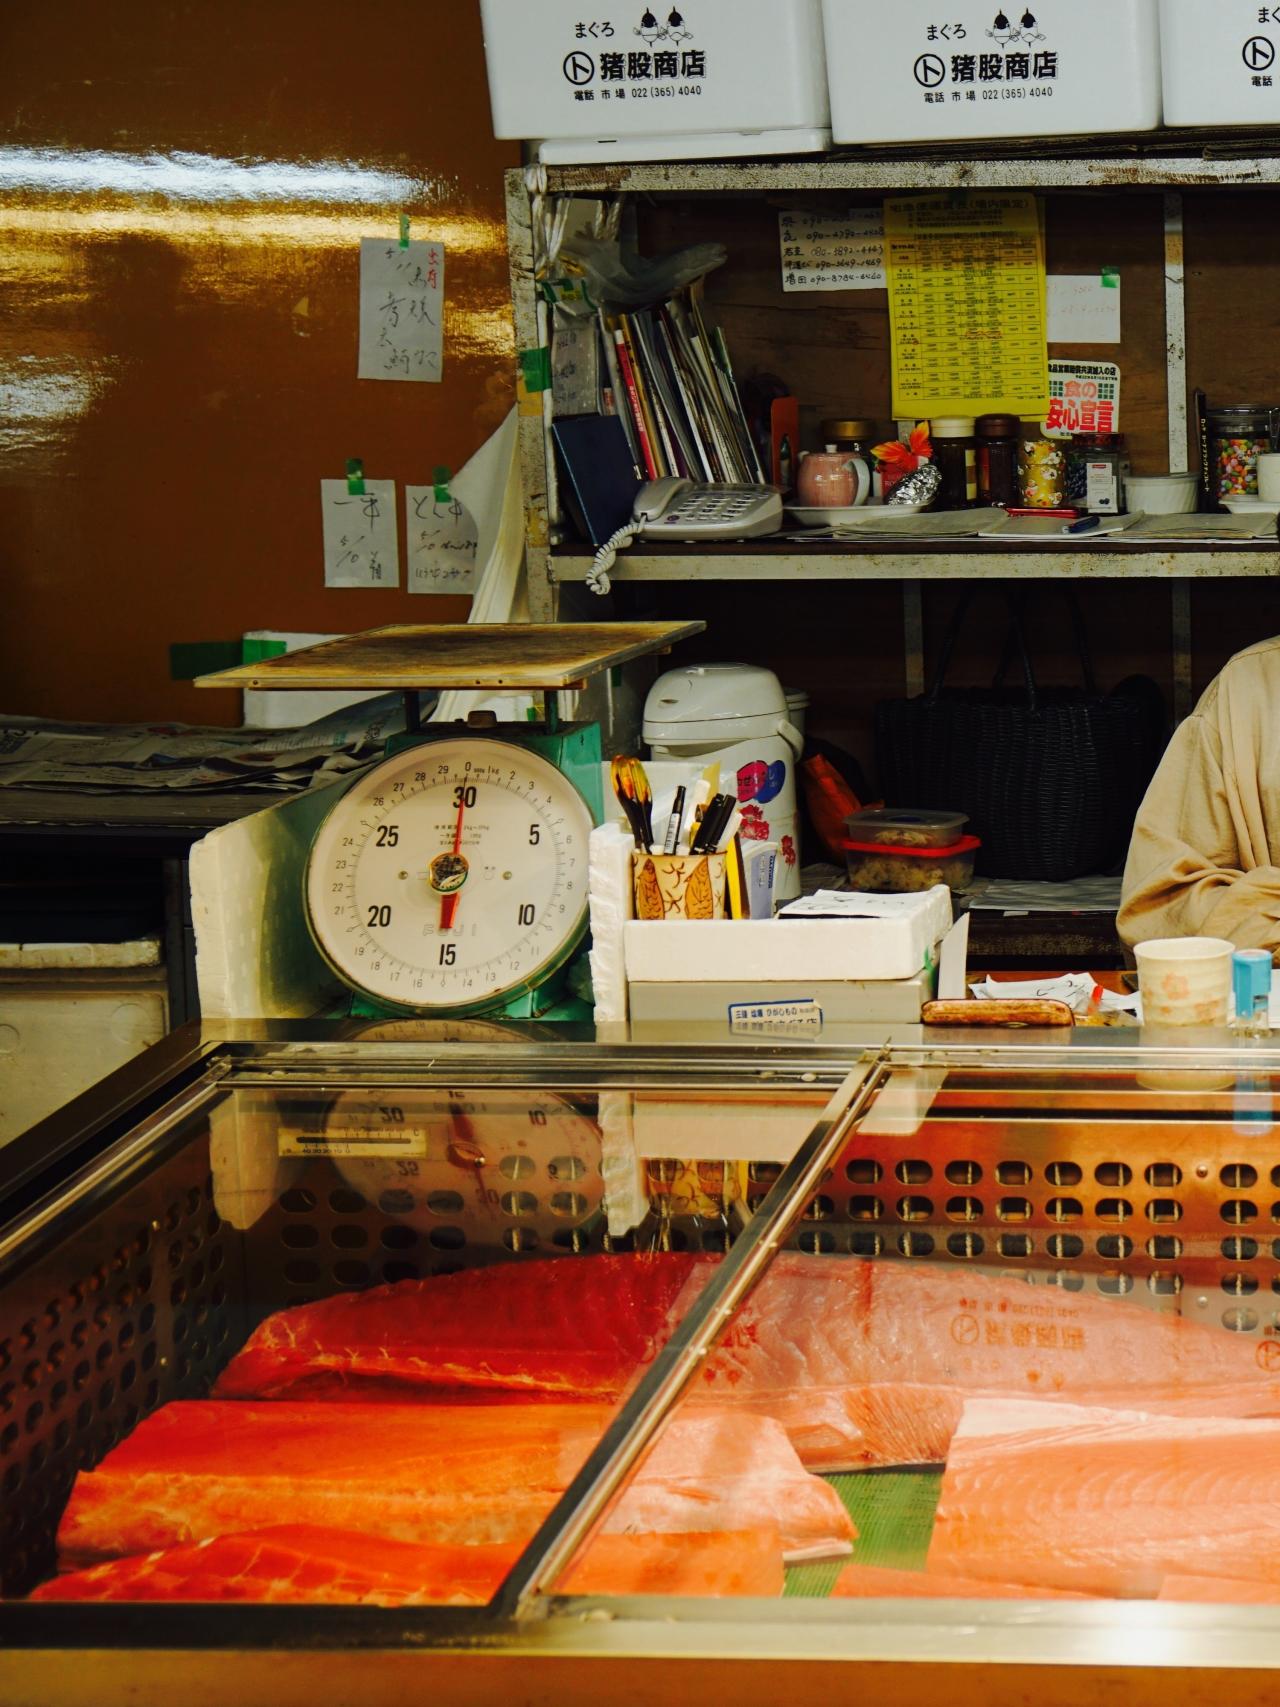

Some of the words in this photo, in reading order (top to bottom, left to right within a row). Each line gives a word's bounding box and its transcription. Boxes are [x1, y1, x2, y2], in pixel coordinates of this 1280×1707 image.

[575, 21, 615, 39] まぐろ
[926, 23, 967, 41] まぐろ
[599, 49, 707, 82] 猪股商店
[951, 50, 1059, 84] 猪股商店
[1251, 75, 1273, 87] 電話
[573, 89, 594, 101] 電話
[923, 92, 945, 104] 電話
[1064, 380, 1097, 398] 食の
[1046, 398, 1114, 433] 安心宣言
[438, 765, 449, 775] 29
[415, 772, 427, 782] 28
[393, 783, 405, 792] 27
[373, 797, 385, 807] 26
[452, 786, 477, 809] 30
[375, 825, 400, 848] 25
[529, 824, 540, 846] 5
[342, 837, 354, 847] 24
[335, 860, 347, 869] 23
[331, 883, 344, 892] 22
[367, 904, 392, 928] 20
[518, 903, 536, 926] 10
[439, 943, 456, 966] 15
[510, 961, 520, 970] 12
[412, 978, 423, 988] 16
[461, 978, 473, 988] 14
[485, 972, 496, 982] 13
